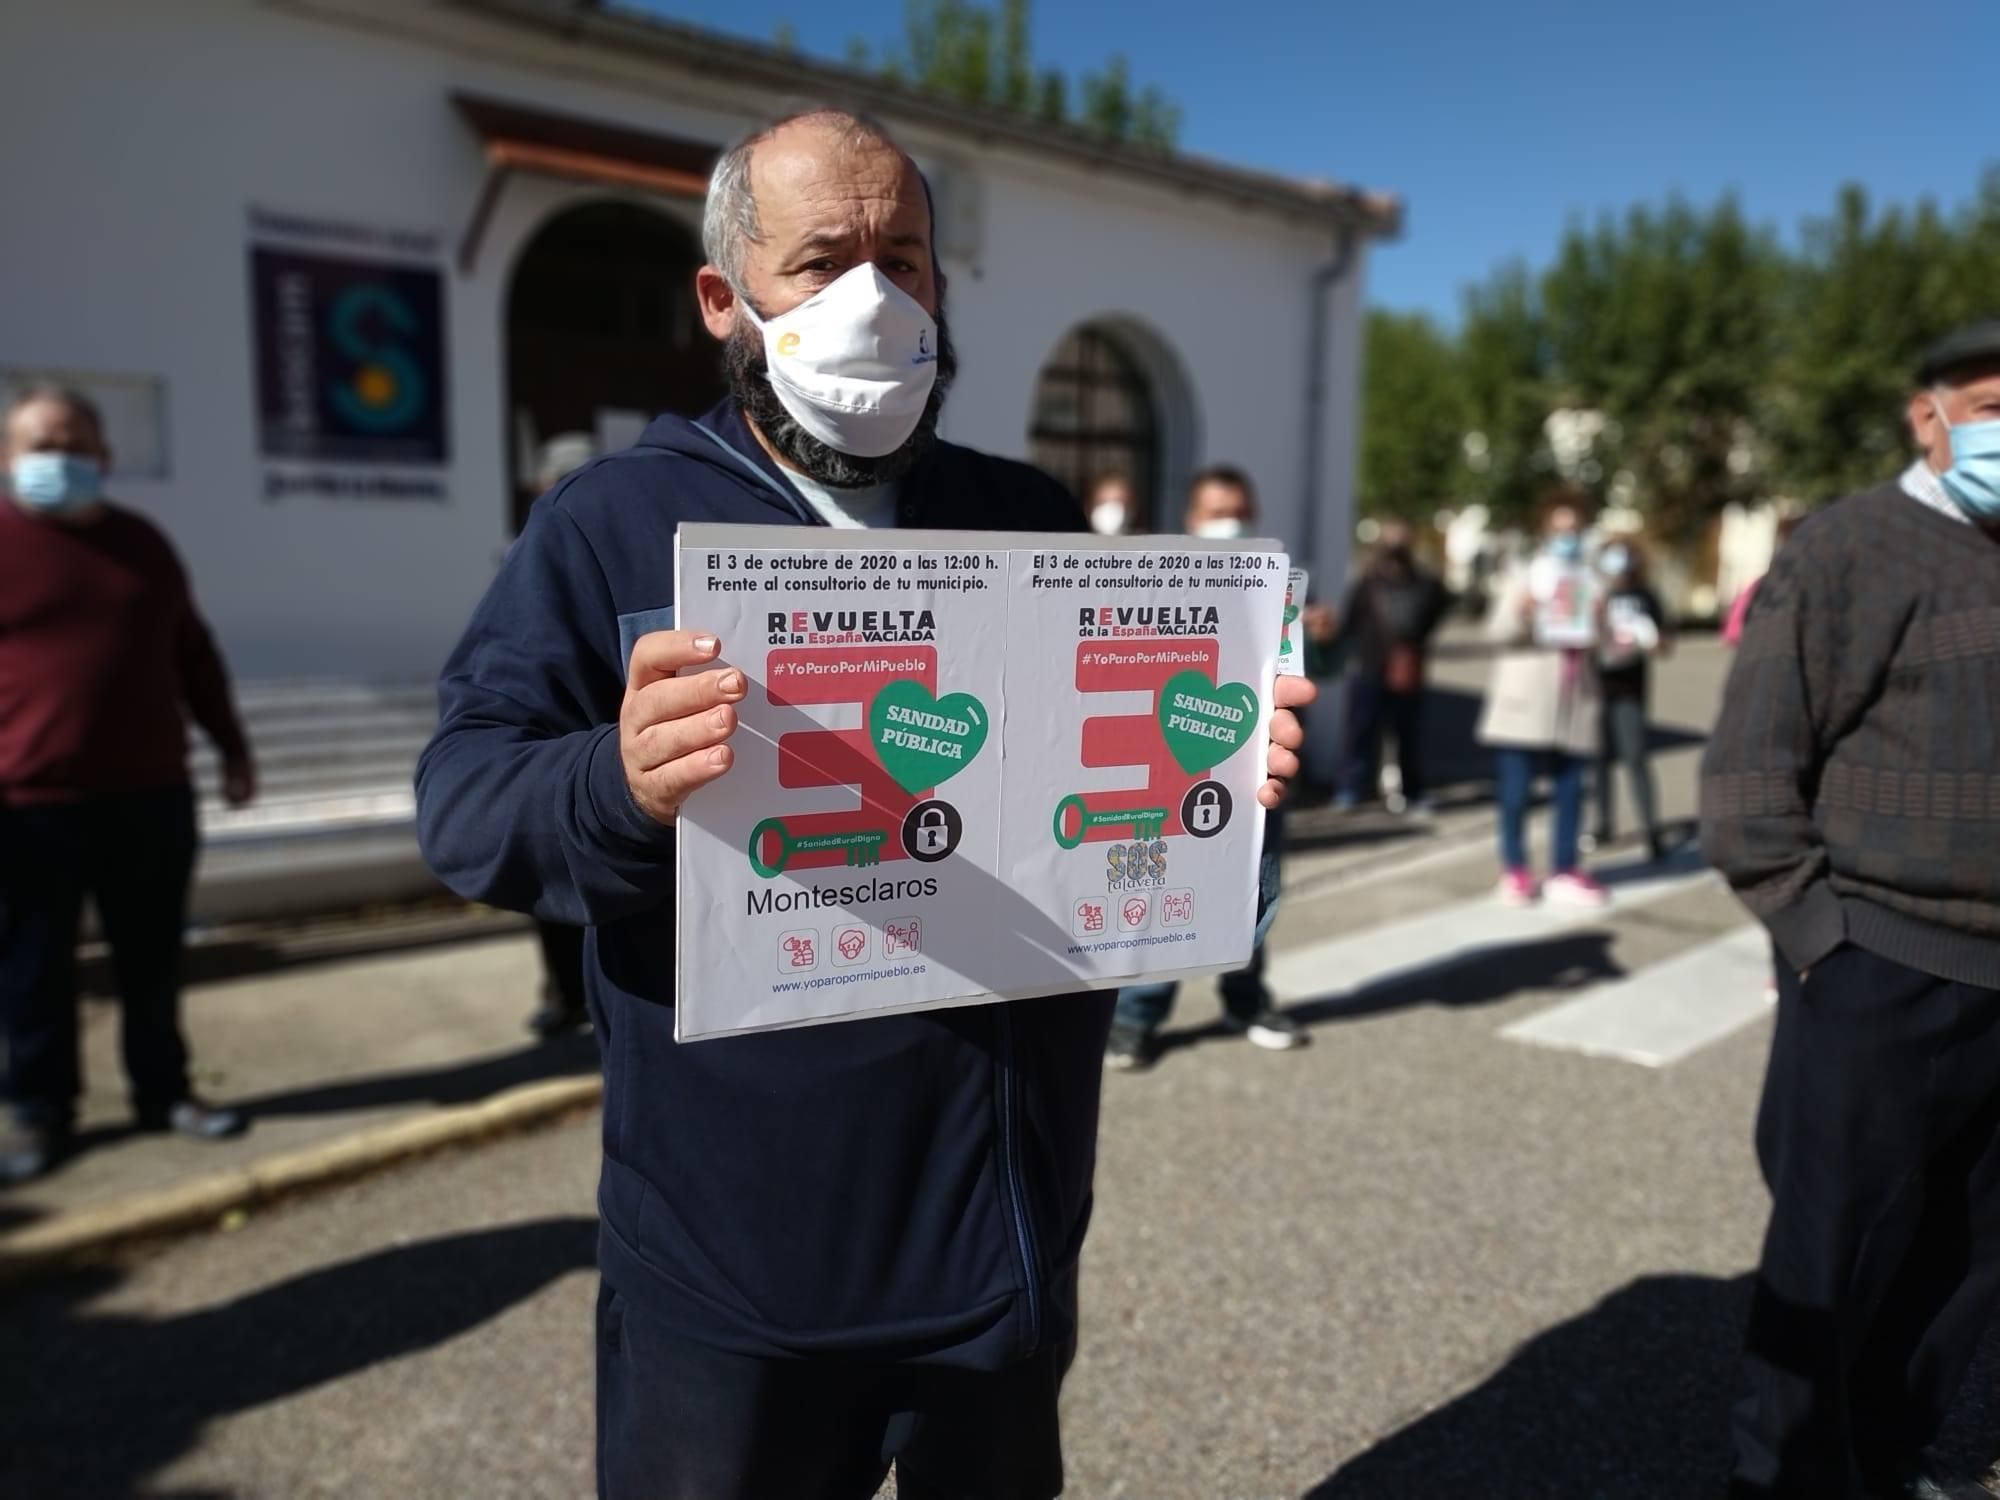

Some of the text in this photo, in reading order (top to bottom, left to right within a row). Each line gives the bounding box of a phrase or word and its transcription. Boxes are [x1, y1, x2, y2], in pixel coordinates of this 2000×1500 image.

[707, 553, 999, 570] El 3 de octubre de 2020 a las 12:00 h.
[1033, 554, 1280, 570] El 3 de octubre de 2020 a las 12:00 h.
[707, 575, 989, 594] Frente al consultorio de tu municipio.
[1032, 574, 1268, 591] Frente al consultorio de tu municipio.
[767, 610, 937, 633] REVUELTA
[1079, 606, 1220, 626] REVUELTA
[768, 633, 785, 644] de
[790, 633, 804, 644] la
[1079, 626, 1094, 637] de
[1097, 626, 1109, 637] la
[774, 659, 927, 677] #YoParoPorMiPueblo
[1082, 652, 1210, 666] #YoParoPorMiPueblo
[1173, 692, 1244, 724] SANIDAD
[886, 704, 971, 738] SANIDAD
[1167, 713, 1237, 744] PÚBLICA
[880, 727, 964, 760] PÚBLICA
[1106, 840, 1168, 883] SOS
[746, 877, 938, 916] Montesclaros
[1067, 931, 1198, 955] www.yoparopormipueblo.es
[772, 964, 927, 993] www.yoparopormipueblo.es
